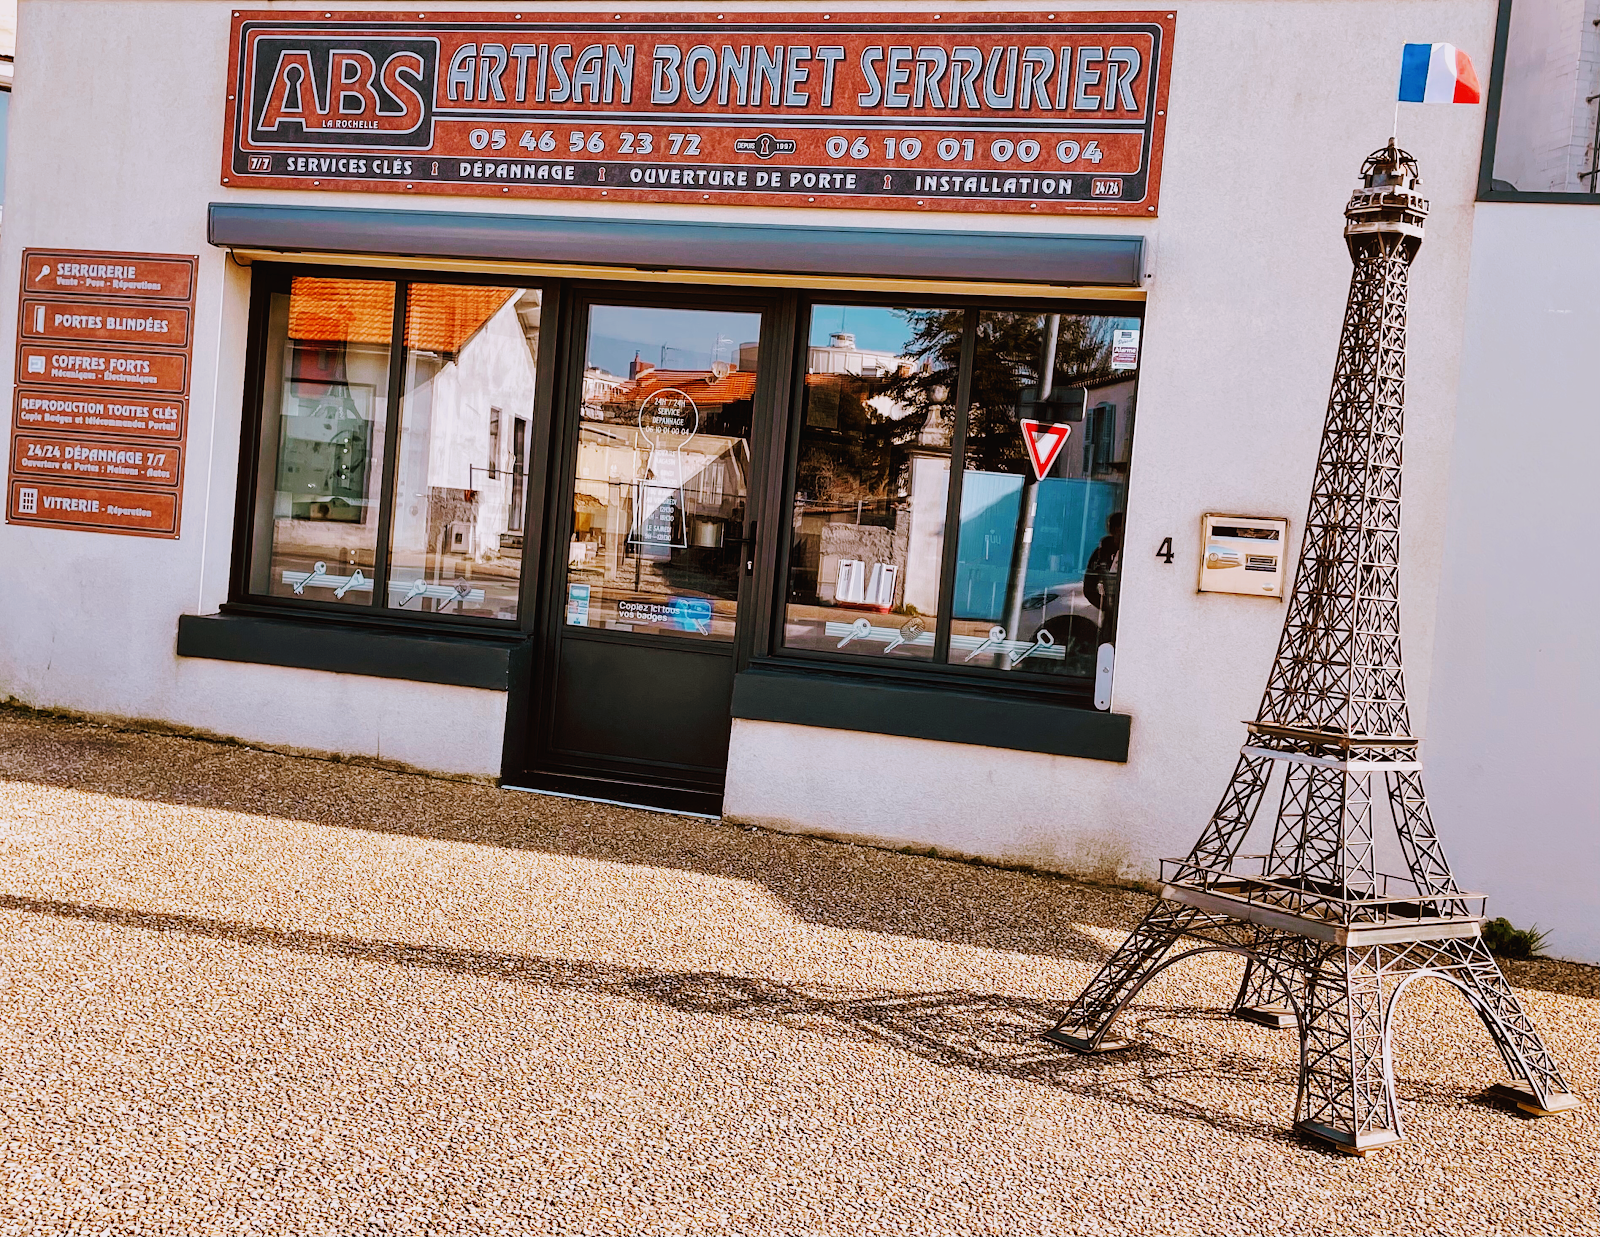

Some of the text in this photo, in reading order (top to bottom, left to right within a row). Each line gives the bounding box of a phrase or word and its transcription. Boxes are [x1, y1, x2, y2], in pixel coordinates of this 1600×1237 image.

[447, 43, 1140, 111] ARTISAN BONNET SERRURIER
[257, 49, 424, 134] ABS
[322, 119, 378, 129] LA ROCHELLE
[469, 129, 701, 155] 05 46 56 23 72
[825, 136, 1102, 164] 06 10 01 00 04
[250, 158, 270, 170] 7/7
[287, 157, 412, 175] SERVICES CLÉS
[459, 161, 575, 180] DÉPANNAGE
[630, 168, 857, 189] OUVERTURE DE PORTE
[915, 175, 1073, 195] INSTALLATION
[1095, 181, 1119, 195] 24/24
[57, 263, 136, 279] SERRURERIE
[56, 277, 78, 286] Vente
[54, 314, 168, 333] PORTES BLINDÉES
[52, 355, 150, 374] COFFRES FORTS
[21, 398, 178, 420] REPRODUCTION TOUTES CLÉS
[658, 408, 680, 416] SERVICE
[27, 443, 166, 467] 24/24 DÉPANNAGE 7/7
[43, 495, 99, 513] VITRERIE
[1156, 536, 1175, 564] 4
[619, 601, 648, 612] Copiez
[662, 606, 681, 615] tous
[619, 611, 668, 623] vos badges
